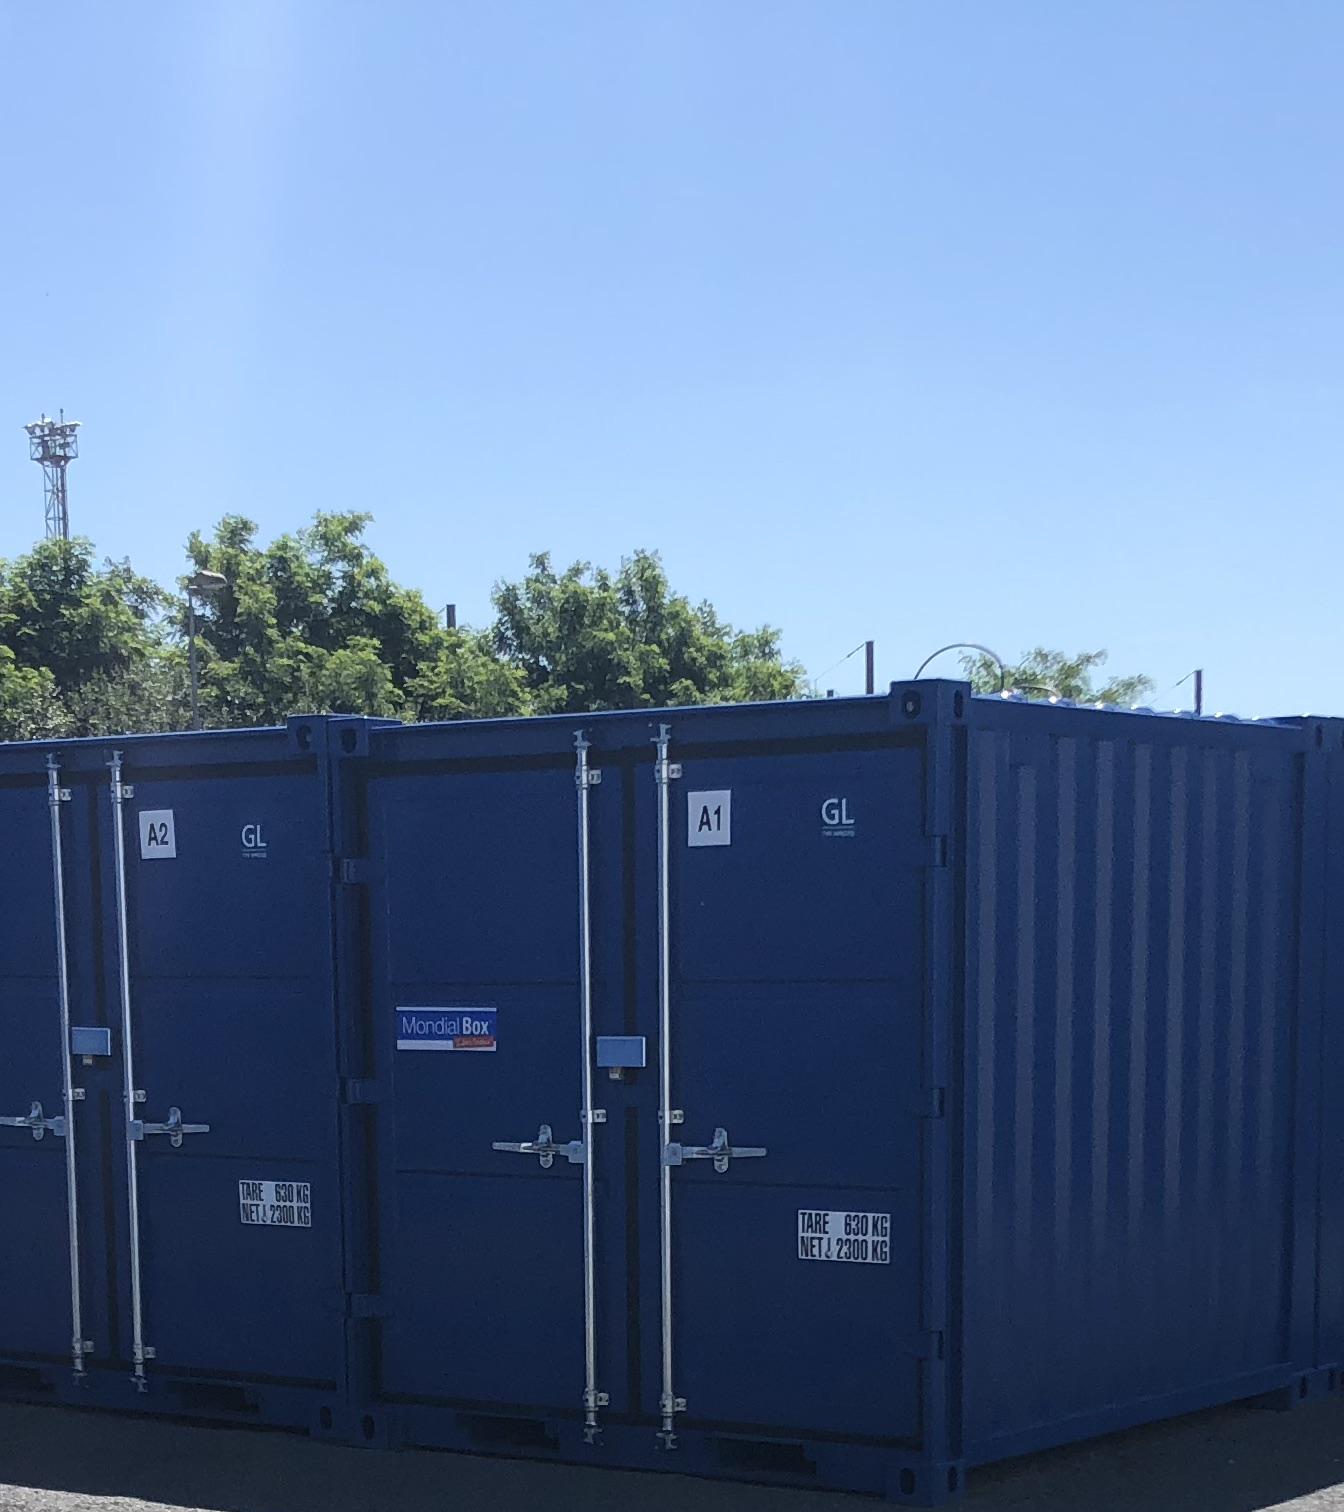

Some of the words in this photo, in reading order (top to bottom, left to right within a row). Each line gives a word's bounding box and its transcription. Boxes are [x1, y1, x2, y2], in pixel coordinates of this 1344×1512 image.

[698, 805, 721, 833] A1
[821, 798, 855, 825] GL
[147, 822, 169, 846] A2
[241, 824, 267, 847] GL
[240, 1182, 264, 1201] TARE
[275, 1184, 294, 1203] 630
[296, 1184, 309, 1204] KG
[270, 1204, 295, 1224] 2300
[296, 1206, 309, 1225] KG
[800, 1212, 829, 1234] TARE
[844, 1214, 869, 1237] 630
[872, 1215, 888, 1238] KG
[836, 1237, 868, 1260] 2300
[871, 1240, 888, 1262] KG
